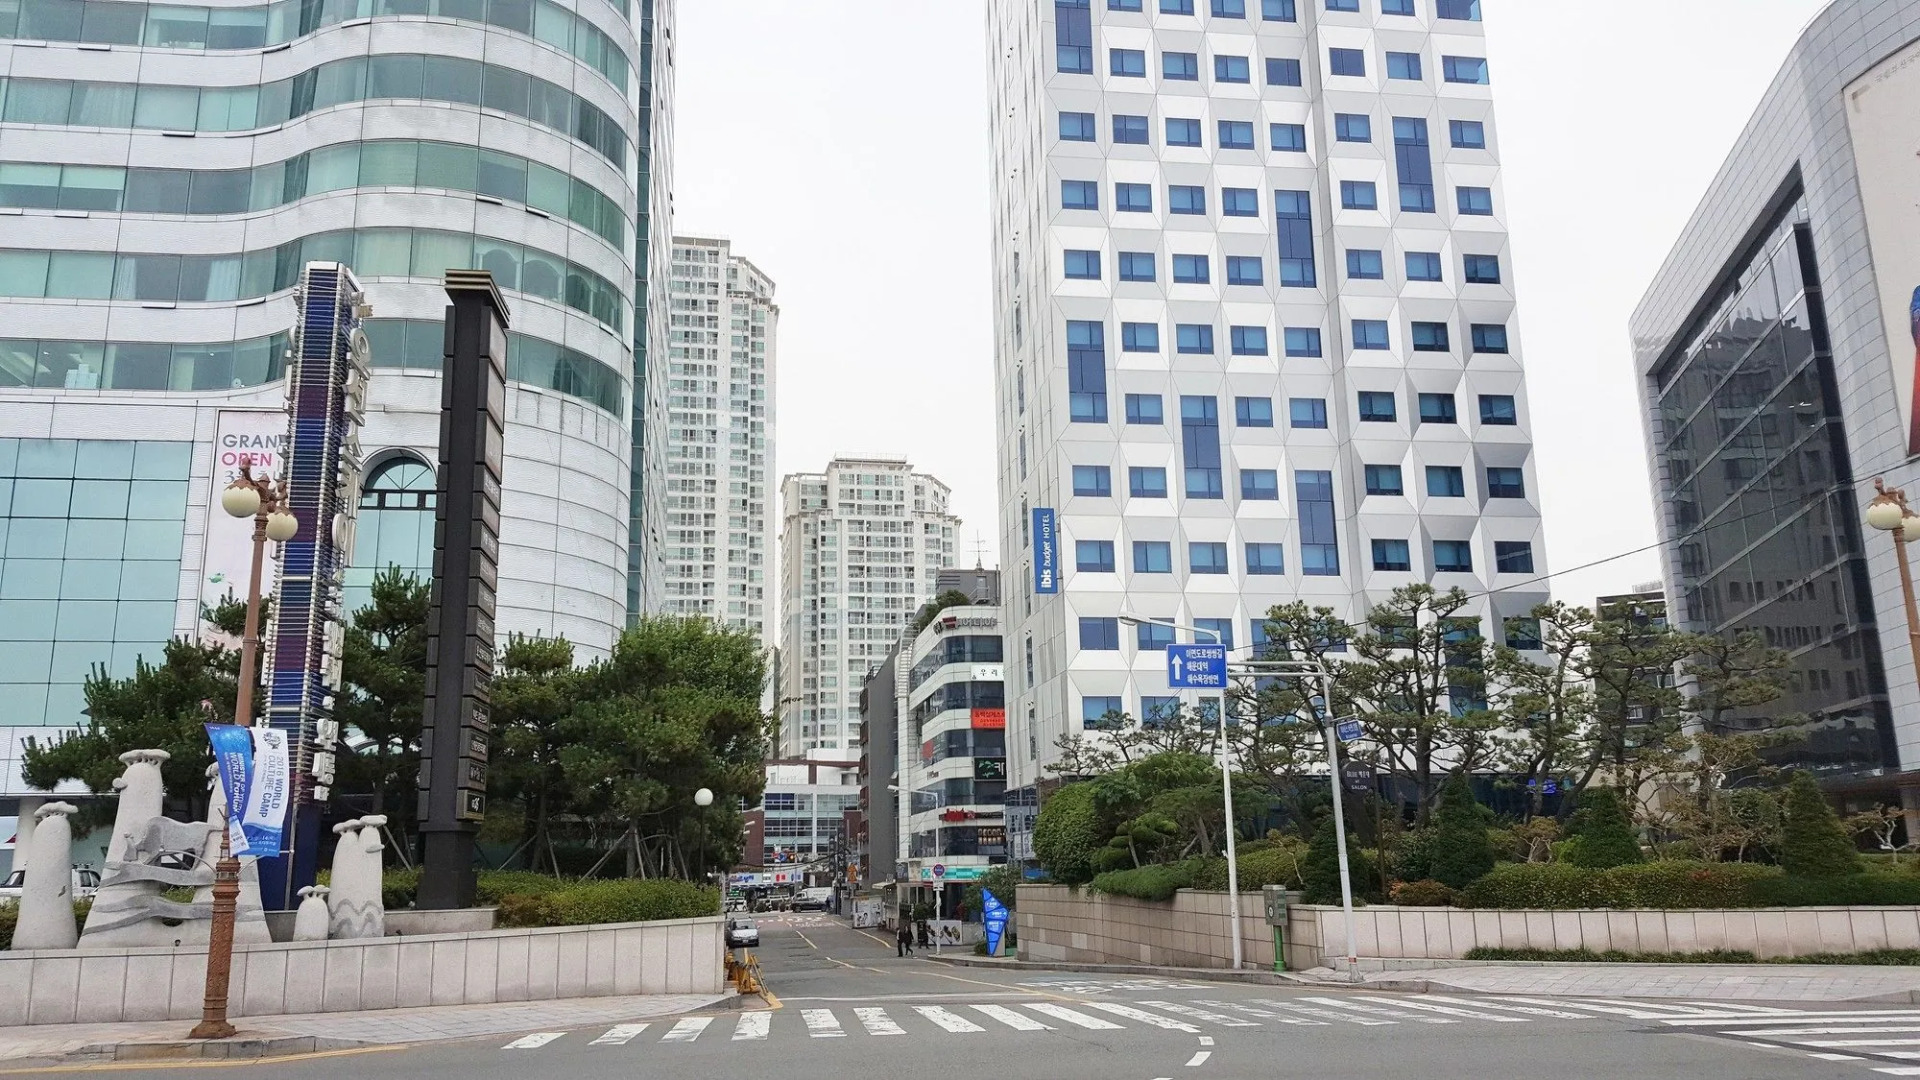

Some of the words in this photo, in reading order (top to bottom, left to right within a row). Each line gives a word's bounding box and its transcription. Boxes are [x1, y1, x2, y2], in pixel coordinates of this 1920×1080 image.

[222, 434, 280, 448] GRAN
[1042, 514, 1050, 539] HOTEL
[1043, 541, 1053, 567] budget
[1041, 569, 1052, 588] ibis
[230, 752, 240, 780] WORLD
[264, 755, 276, 790] CULTURE
[276, 756, 284, 776] 2016
[258, 792, 272, 818] CAMP
[271, 778, 284, 809] WORLD
